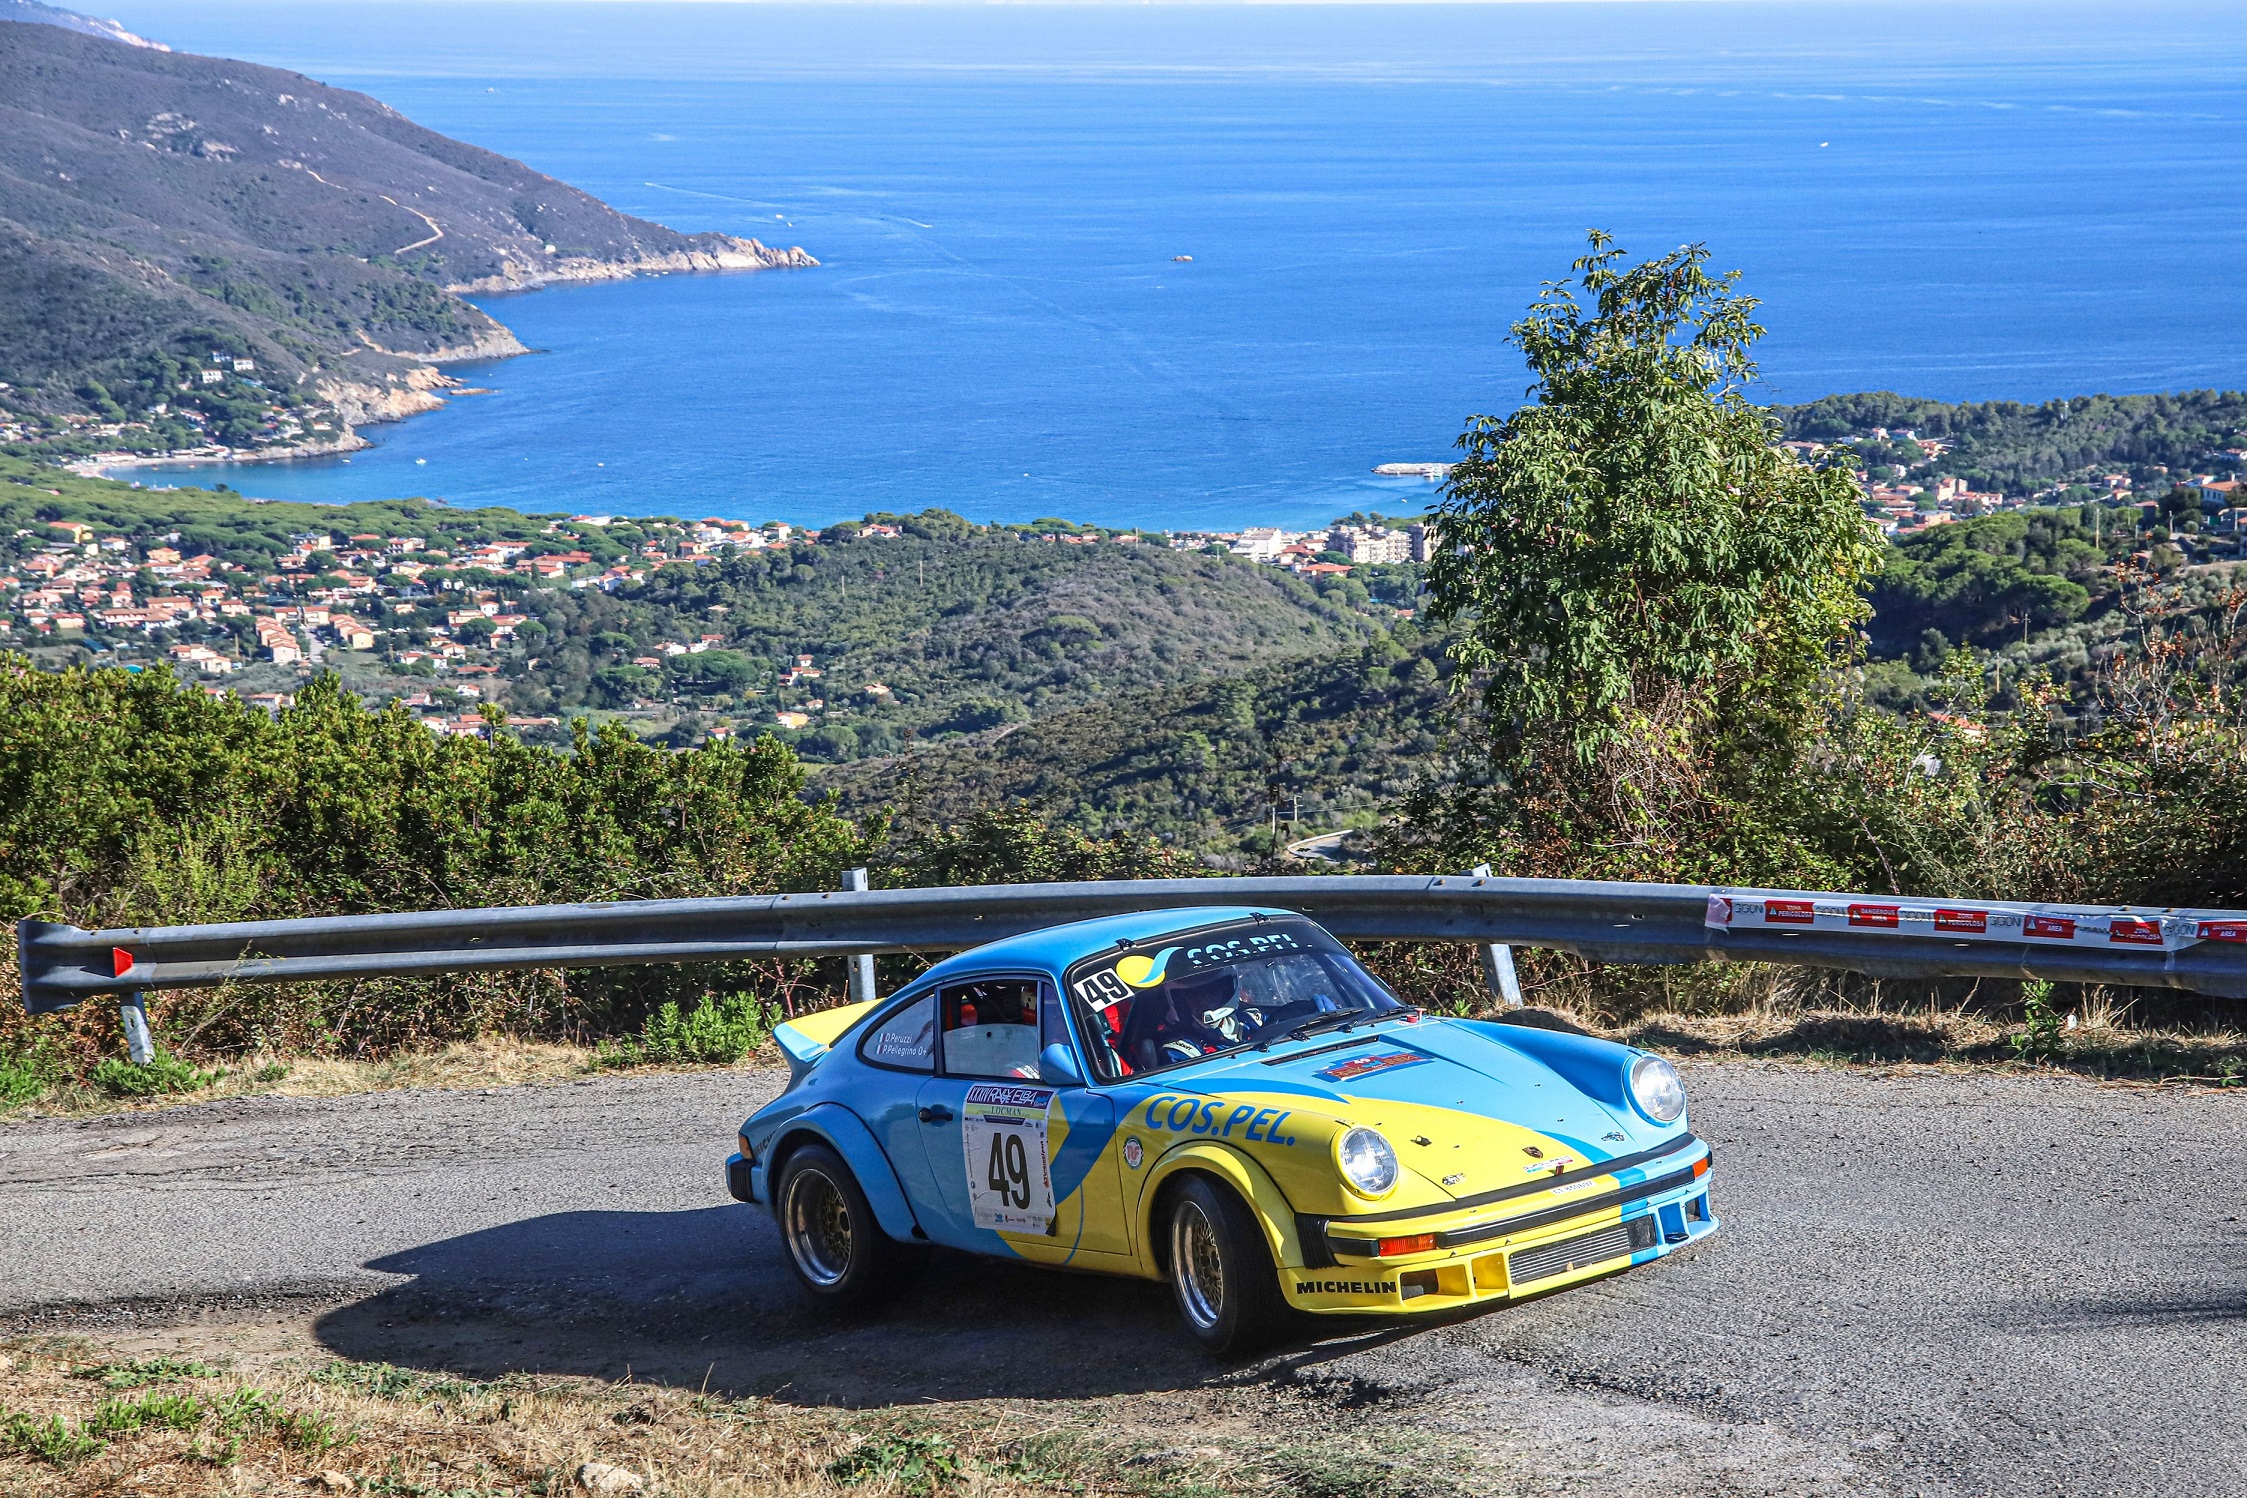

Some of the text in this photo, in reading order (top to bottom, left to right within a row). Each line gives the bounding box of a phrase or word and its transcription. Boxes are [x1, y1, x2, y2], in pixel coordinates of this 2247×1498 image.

[1778, 910, 1813, 918] PERICOLOSA
[1082, 971, 1129, 1004] 49
[992, 1106, 1021, 1117] LOCMAN
[1145, 1096, 1296, 1147] COS.PEL.
[988, 1132, 1030, 1210] 49
[1296, 1281, 1397, 1295] MICHELIN
